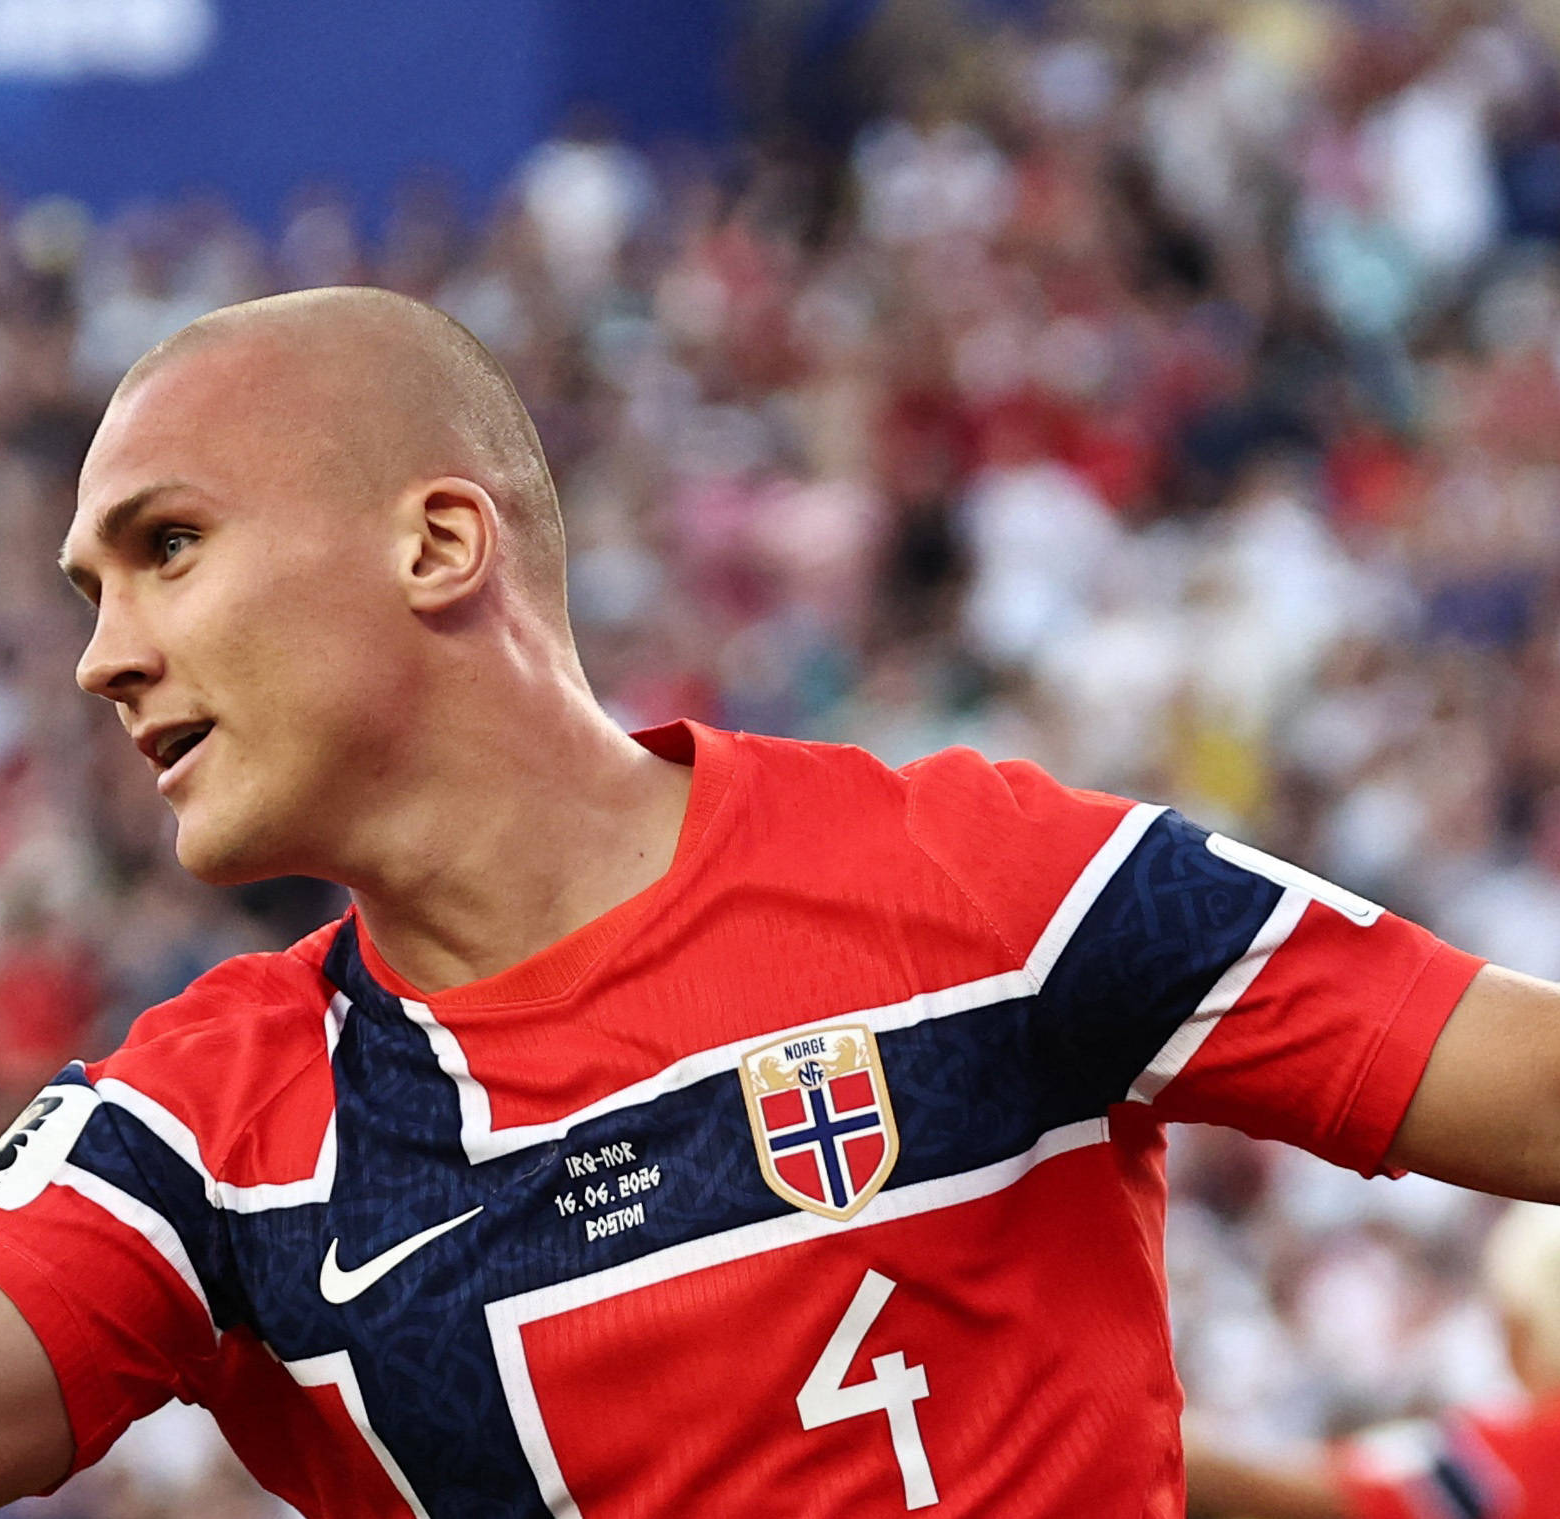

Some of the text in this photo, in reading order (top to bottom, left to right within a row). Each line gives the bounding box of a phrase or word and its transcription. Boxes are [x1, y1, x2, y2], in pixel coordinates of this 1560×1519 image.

[784, 1036, 827, 1061] NORGE
[565, 1141, 637, 1179] IRQ-NOR
[554, 1164, 661, 1217] 16.06.2026
[585, 1202, 646, 1242] BOSTON
[795, 1268, 940, 1511] 4
